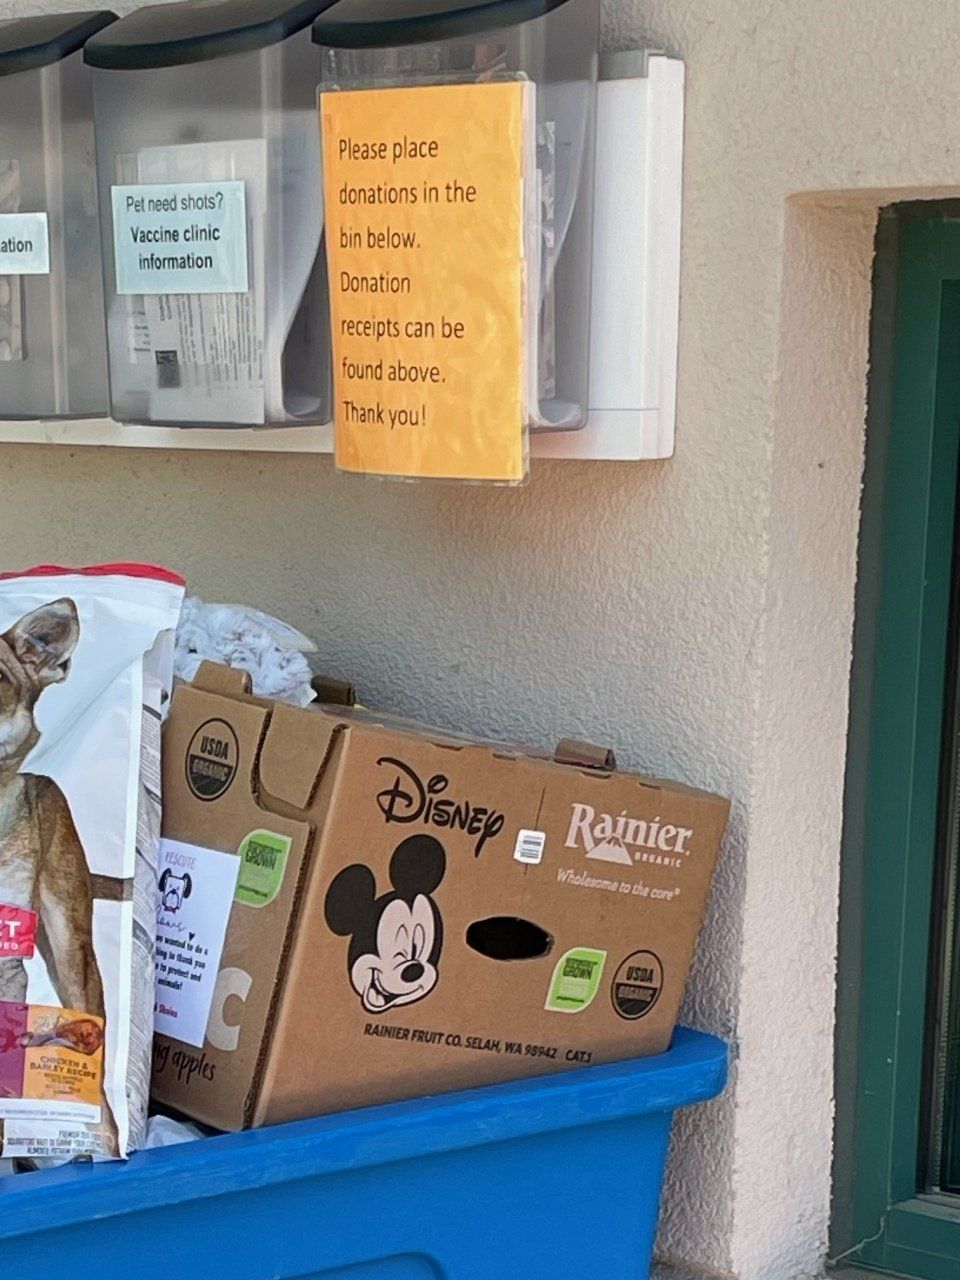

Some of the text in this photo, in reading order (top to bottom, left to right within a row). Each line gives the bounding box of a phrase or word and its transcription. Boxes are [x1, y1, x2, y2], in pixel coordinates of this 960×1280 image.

[339, 136, 439, 164] Please place
[126, 192, 224, 213] Pet need shots?
[339, 180, 477, 205] donations in the
[130, 224, 220, 243] Vaccine clinic
[340, 226, 421, 249] bin below.
[139, 253, 213, 271] information
[340, 271, 411, 294] Donation
[341, 315, 465, 342] receipts can be
[342, 357, 447, 384] found above.
[343, 400, 427, 431] Thank you!
[200, 735, 229, 760] USDA
[634, 851, 682, 868] ORGANIC
[557, 867, 618, 892] Wholesome
[619, 881, 630, 894] to
[631, 880, 650, 898] the
[626, 966, 654, 983] USDA
[364, 1023, 410, 1041] RAINIER
[411, 1029, 444, 1043] FRUIT
[445, 1034, 463, 1048] CO.
[465, 1036, 501, 1053] SELAH,
[504, 1041, 523, 1055] WA
[525, 1046, 557, 1059] 98942
[30, 1062, 64, 1073] BARLEY
[66, 1067, 96, 1080] RECIPE
[40, 1055, 88, 1070] CHICKEN &
[172, 1051, 216, 1085] apples
